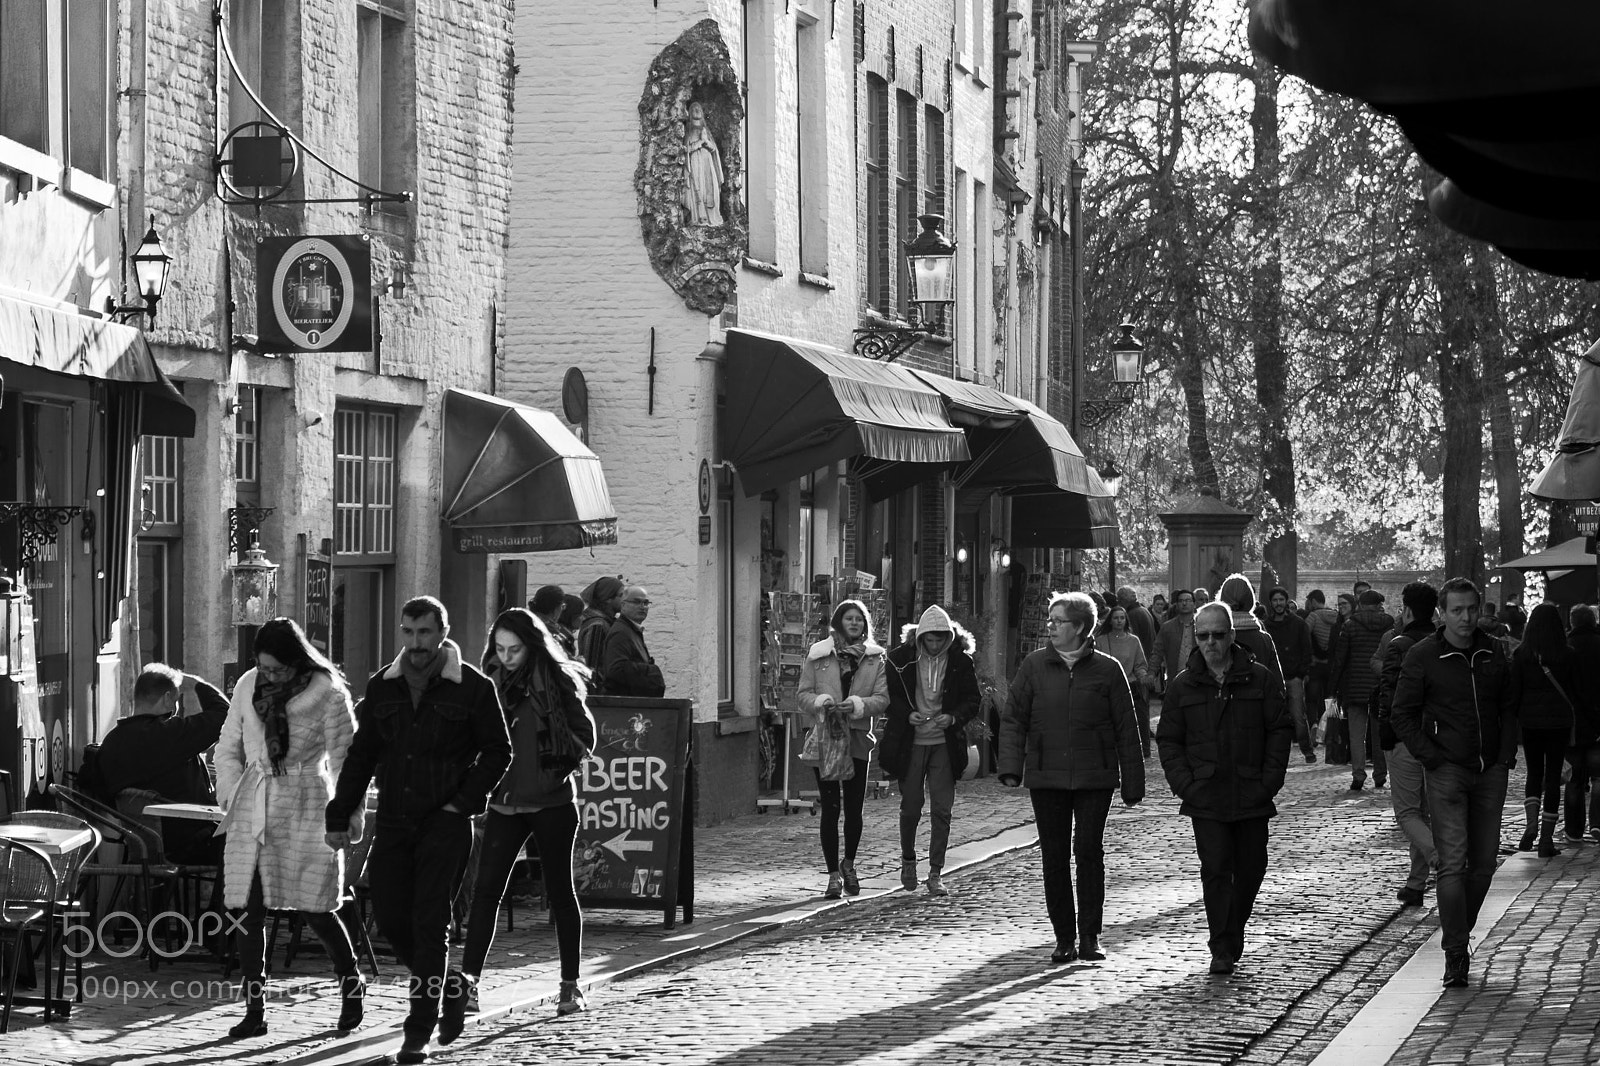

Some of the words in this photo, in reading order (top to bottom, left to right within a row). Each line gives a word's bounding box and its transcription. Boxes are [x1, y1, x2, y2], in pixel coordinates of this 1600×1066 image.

[460, 535, 483, 552] grill
[487, 535, 543, 547] restaurant
[308, 567, 328, 598] BEER
[582, 755, 668, 792] BEER
